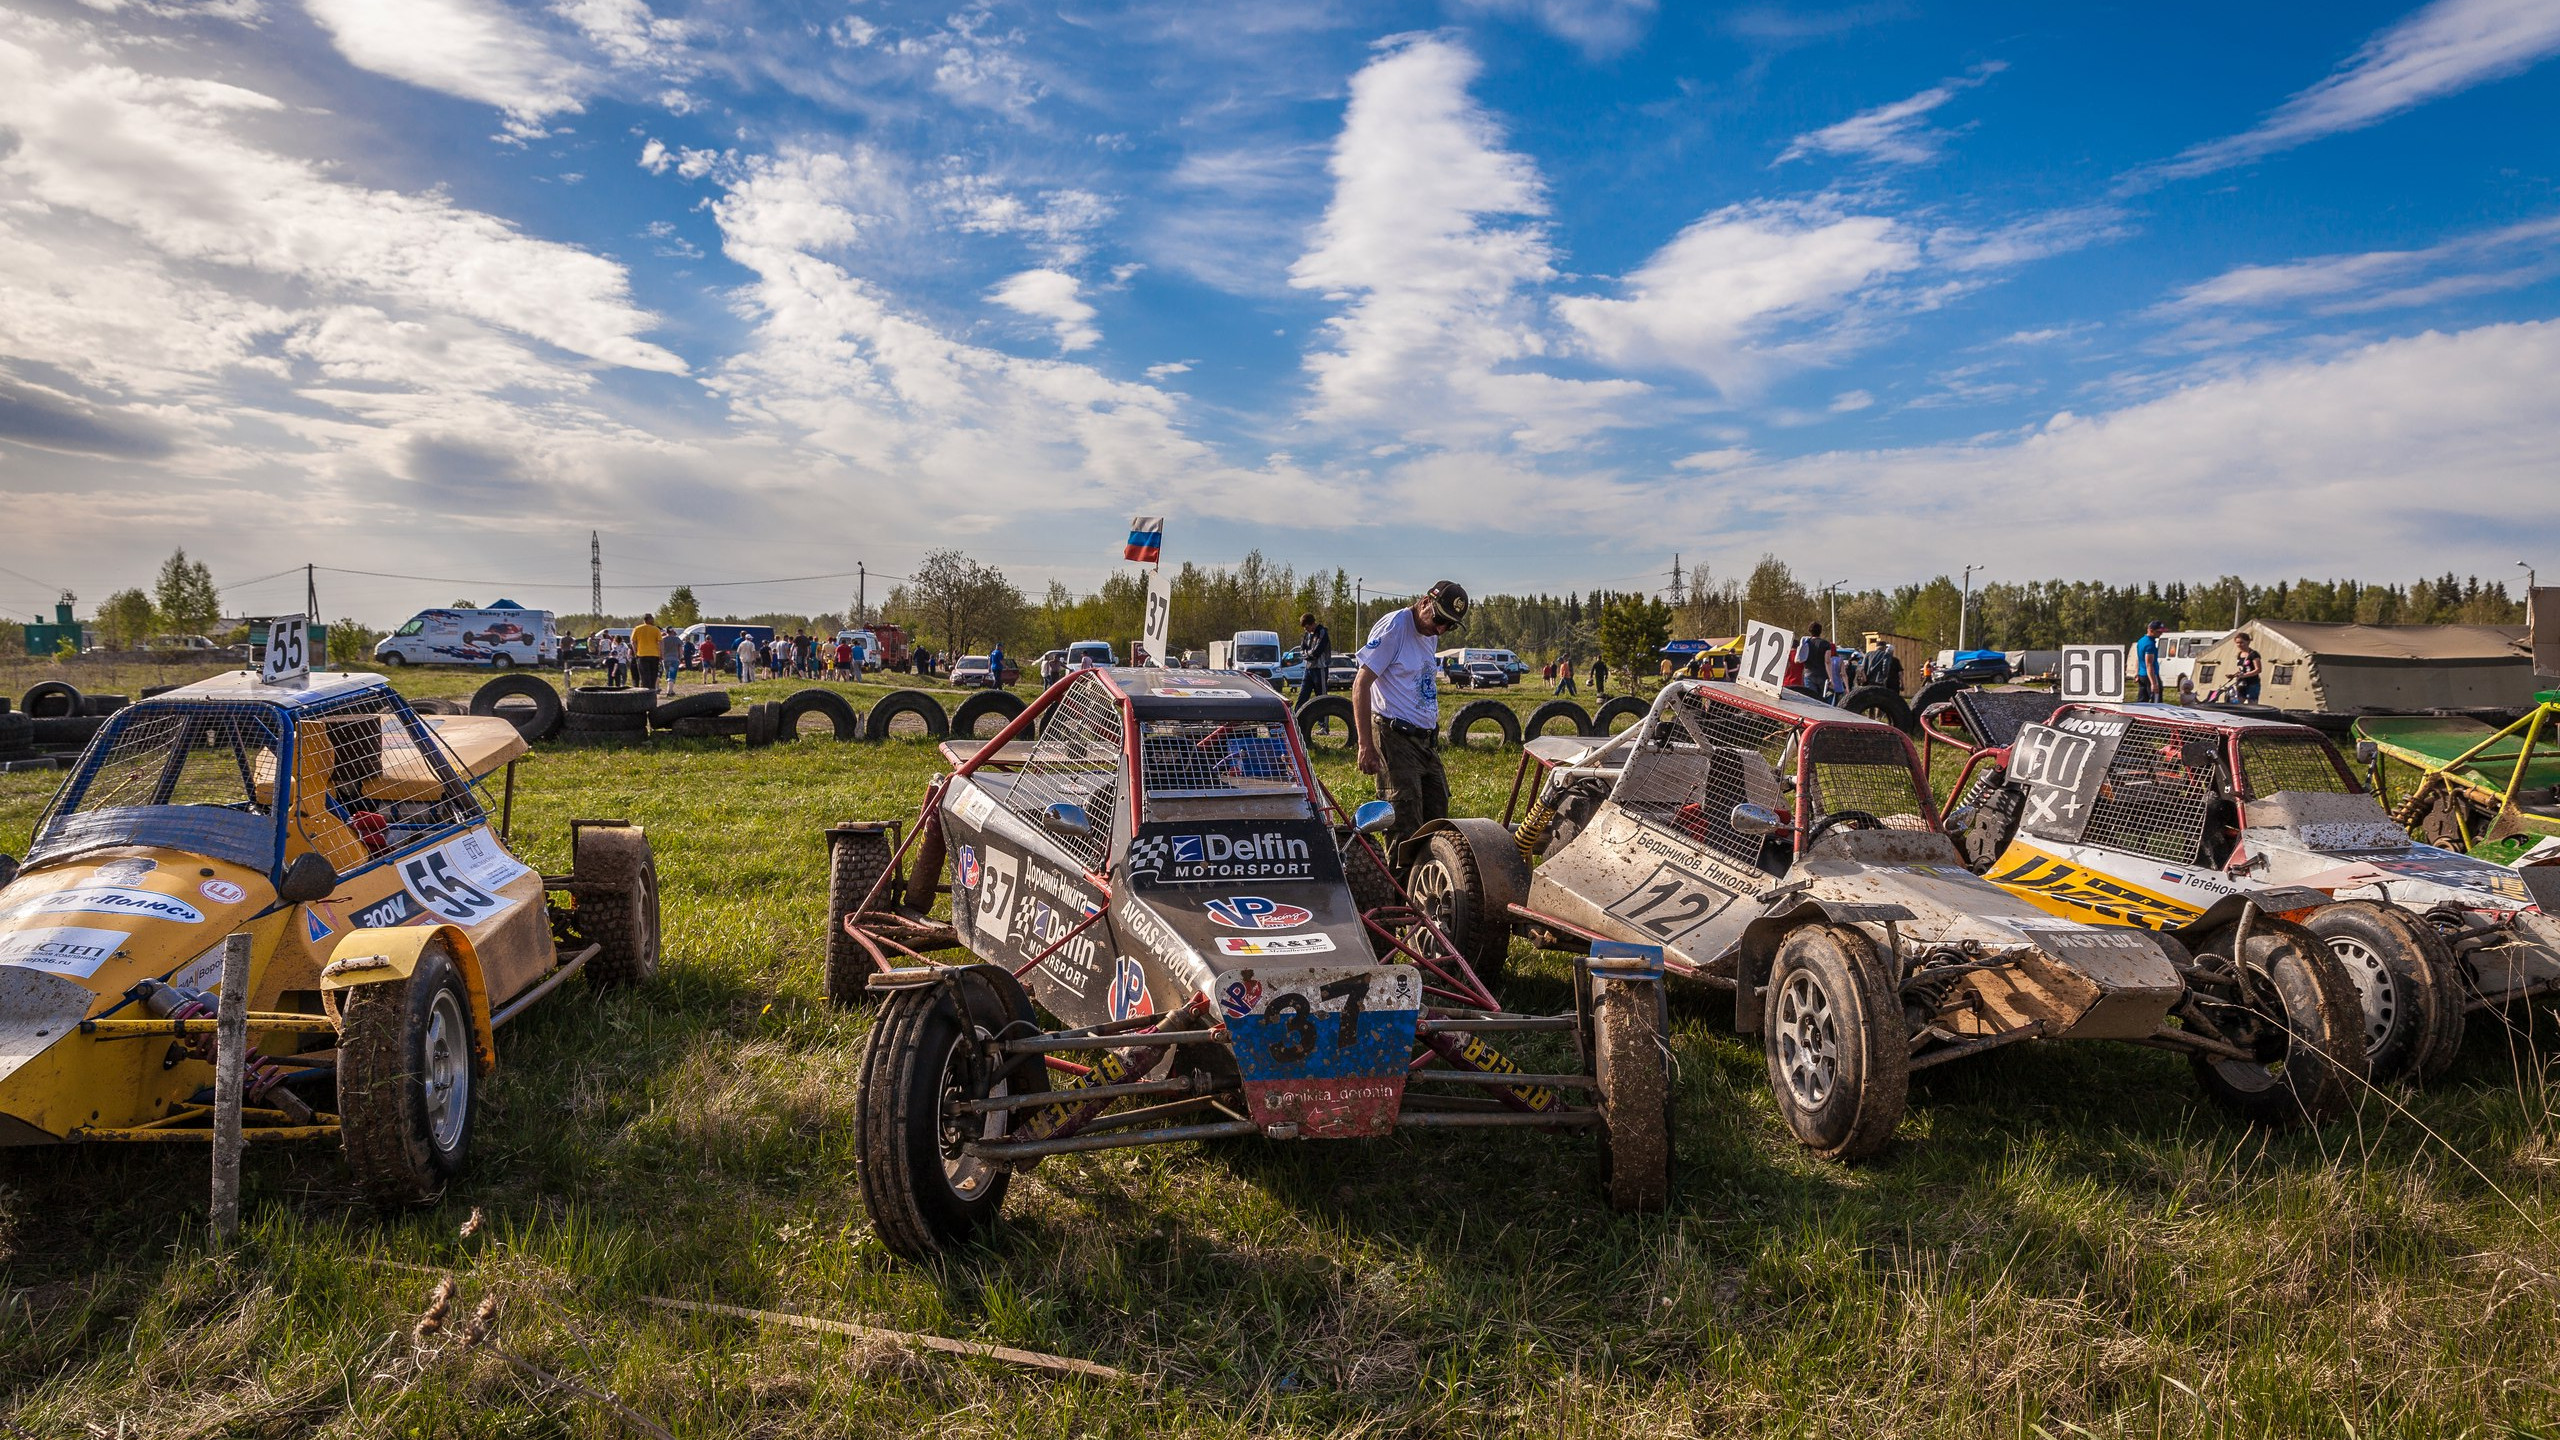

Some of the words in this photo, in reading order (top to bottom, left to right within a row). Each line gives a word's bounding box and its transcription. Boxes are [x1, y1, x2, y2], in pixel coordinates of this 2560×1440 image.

[1146, 592, 1167, 640] 37
[272, 621, 302, 673] 55
[1749, 627, 1784, 686] 12
[2064, 649, 2123, 697] 60
[2059, 717, 2124, 737] MOTUL
[2013, 725, 2094, 791] 60
[1205, 833, 1309, 861] Delfin
[405, 851, 495, 918] 55
[1175, 863, 1311, 877] MOTORSPORT
[1703, 863, 1764, 898] Николай
[363, 894, 407, 928] 300V
[981, 866, 1015, 920] 37
[1058, 874, 1088, 914] Никита
[1203, 896, 1277, 928] VP
[1625, 879, 1709, 937] 12
[1259, 912, 1306, 925] Racing
[1120, 900, 1160, 946] AVGAS
[1164, 946, 1200, 993] 100LL
[1266, 938, 1323, 948] A&P
[2048, 934, 2144, 948] MOTUL
[1221, 981, 1252, 1017] VP
[1263, 972, 1372, 1064] 37
[1463, 1036, 1550, 1111] REGER
